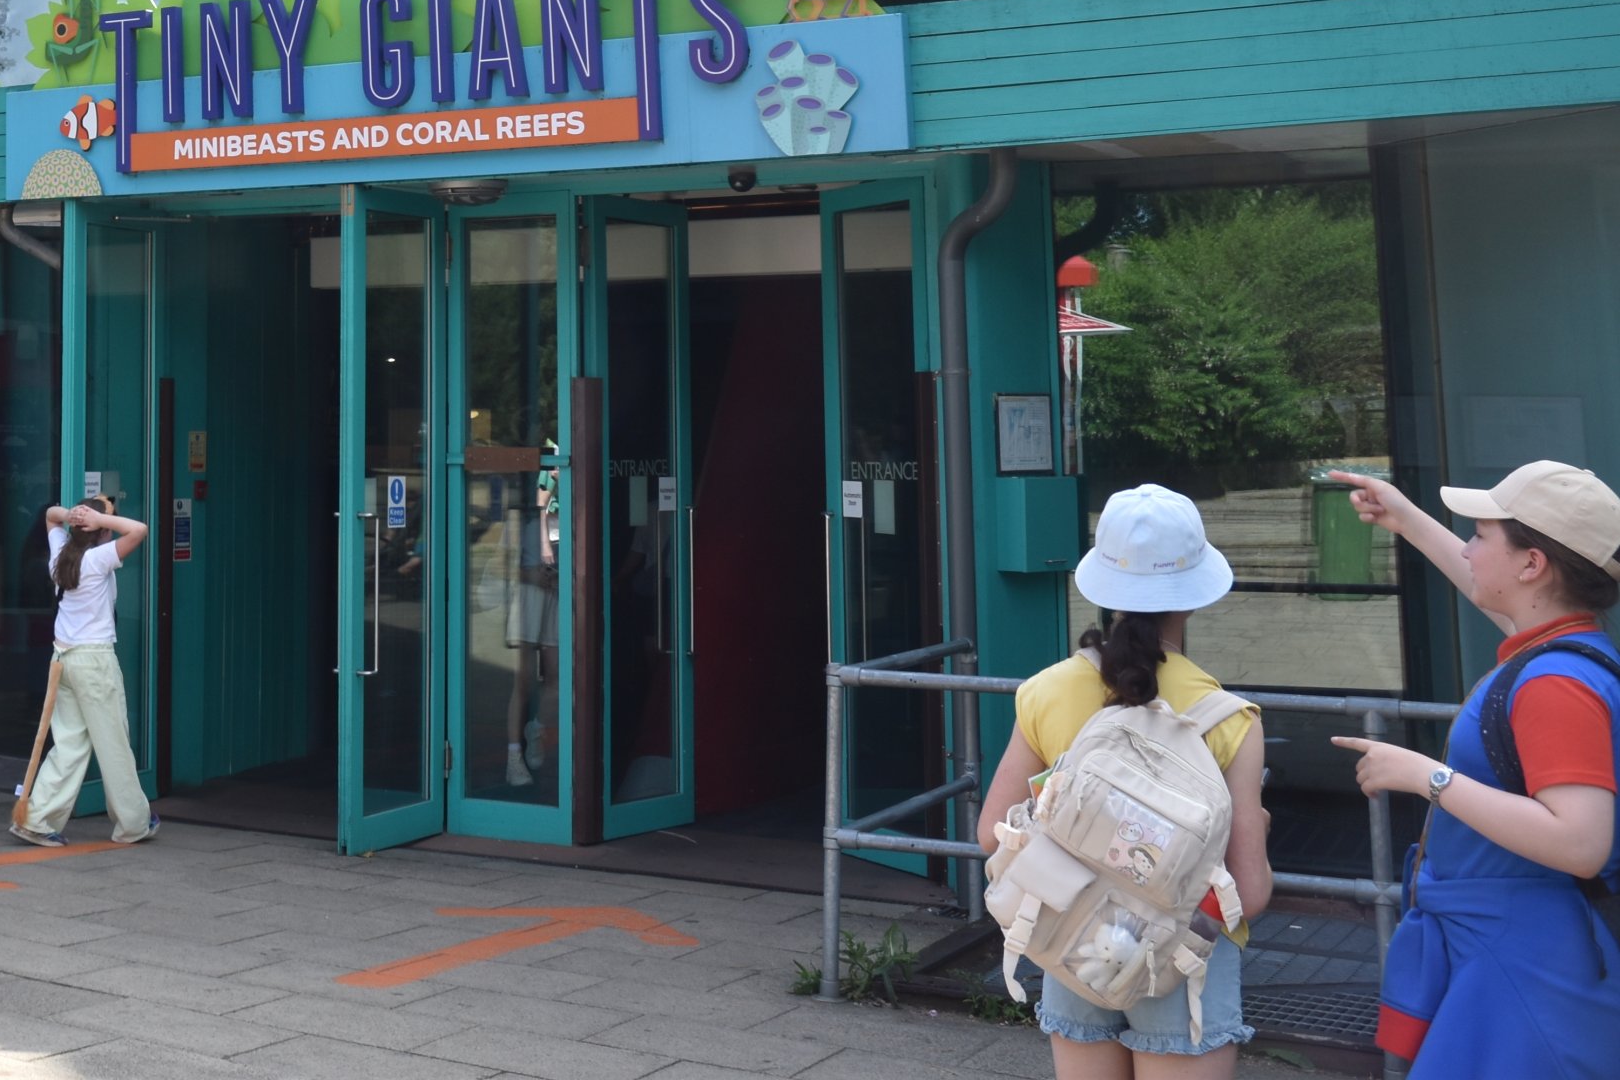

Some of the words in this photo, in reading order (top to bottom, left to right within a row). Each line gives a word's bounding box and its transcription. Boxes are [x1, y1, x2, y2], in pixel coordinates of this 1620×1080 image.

[173, 129, 325, 160] MINIBEASTS
[332, 125, 389, 150] AND
[395, 118, 490, 146] CORAL
[496, 111, 585, 140] REEFS
[609, 458, 668, 477] ENTRANCE
[851, 461, 918, 480] ENTRANCE
